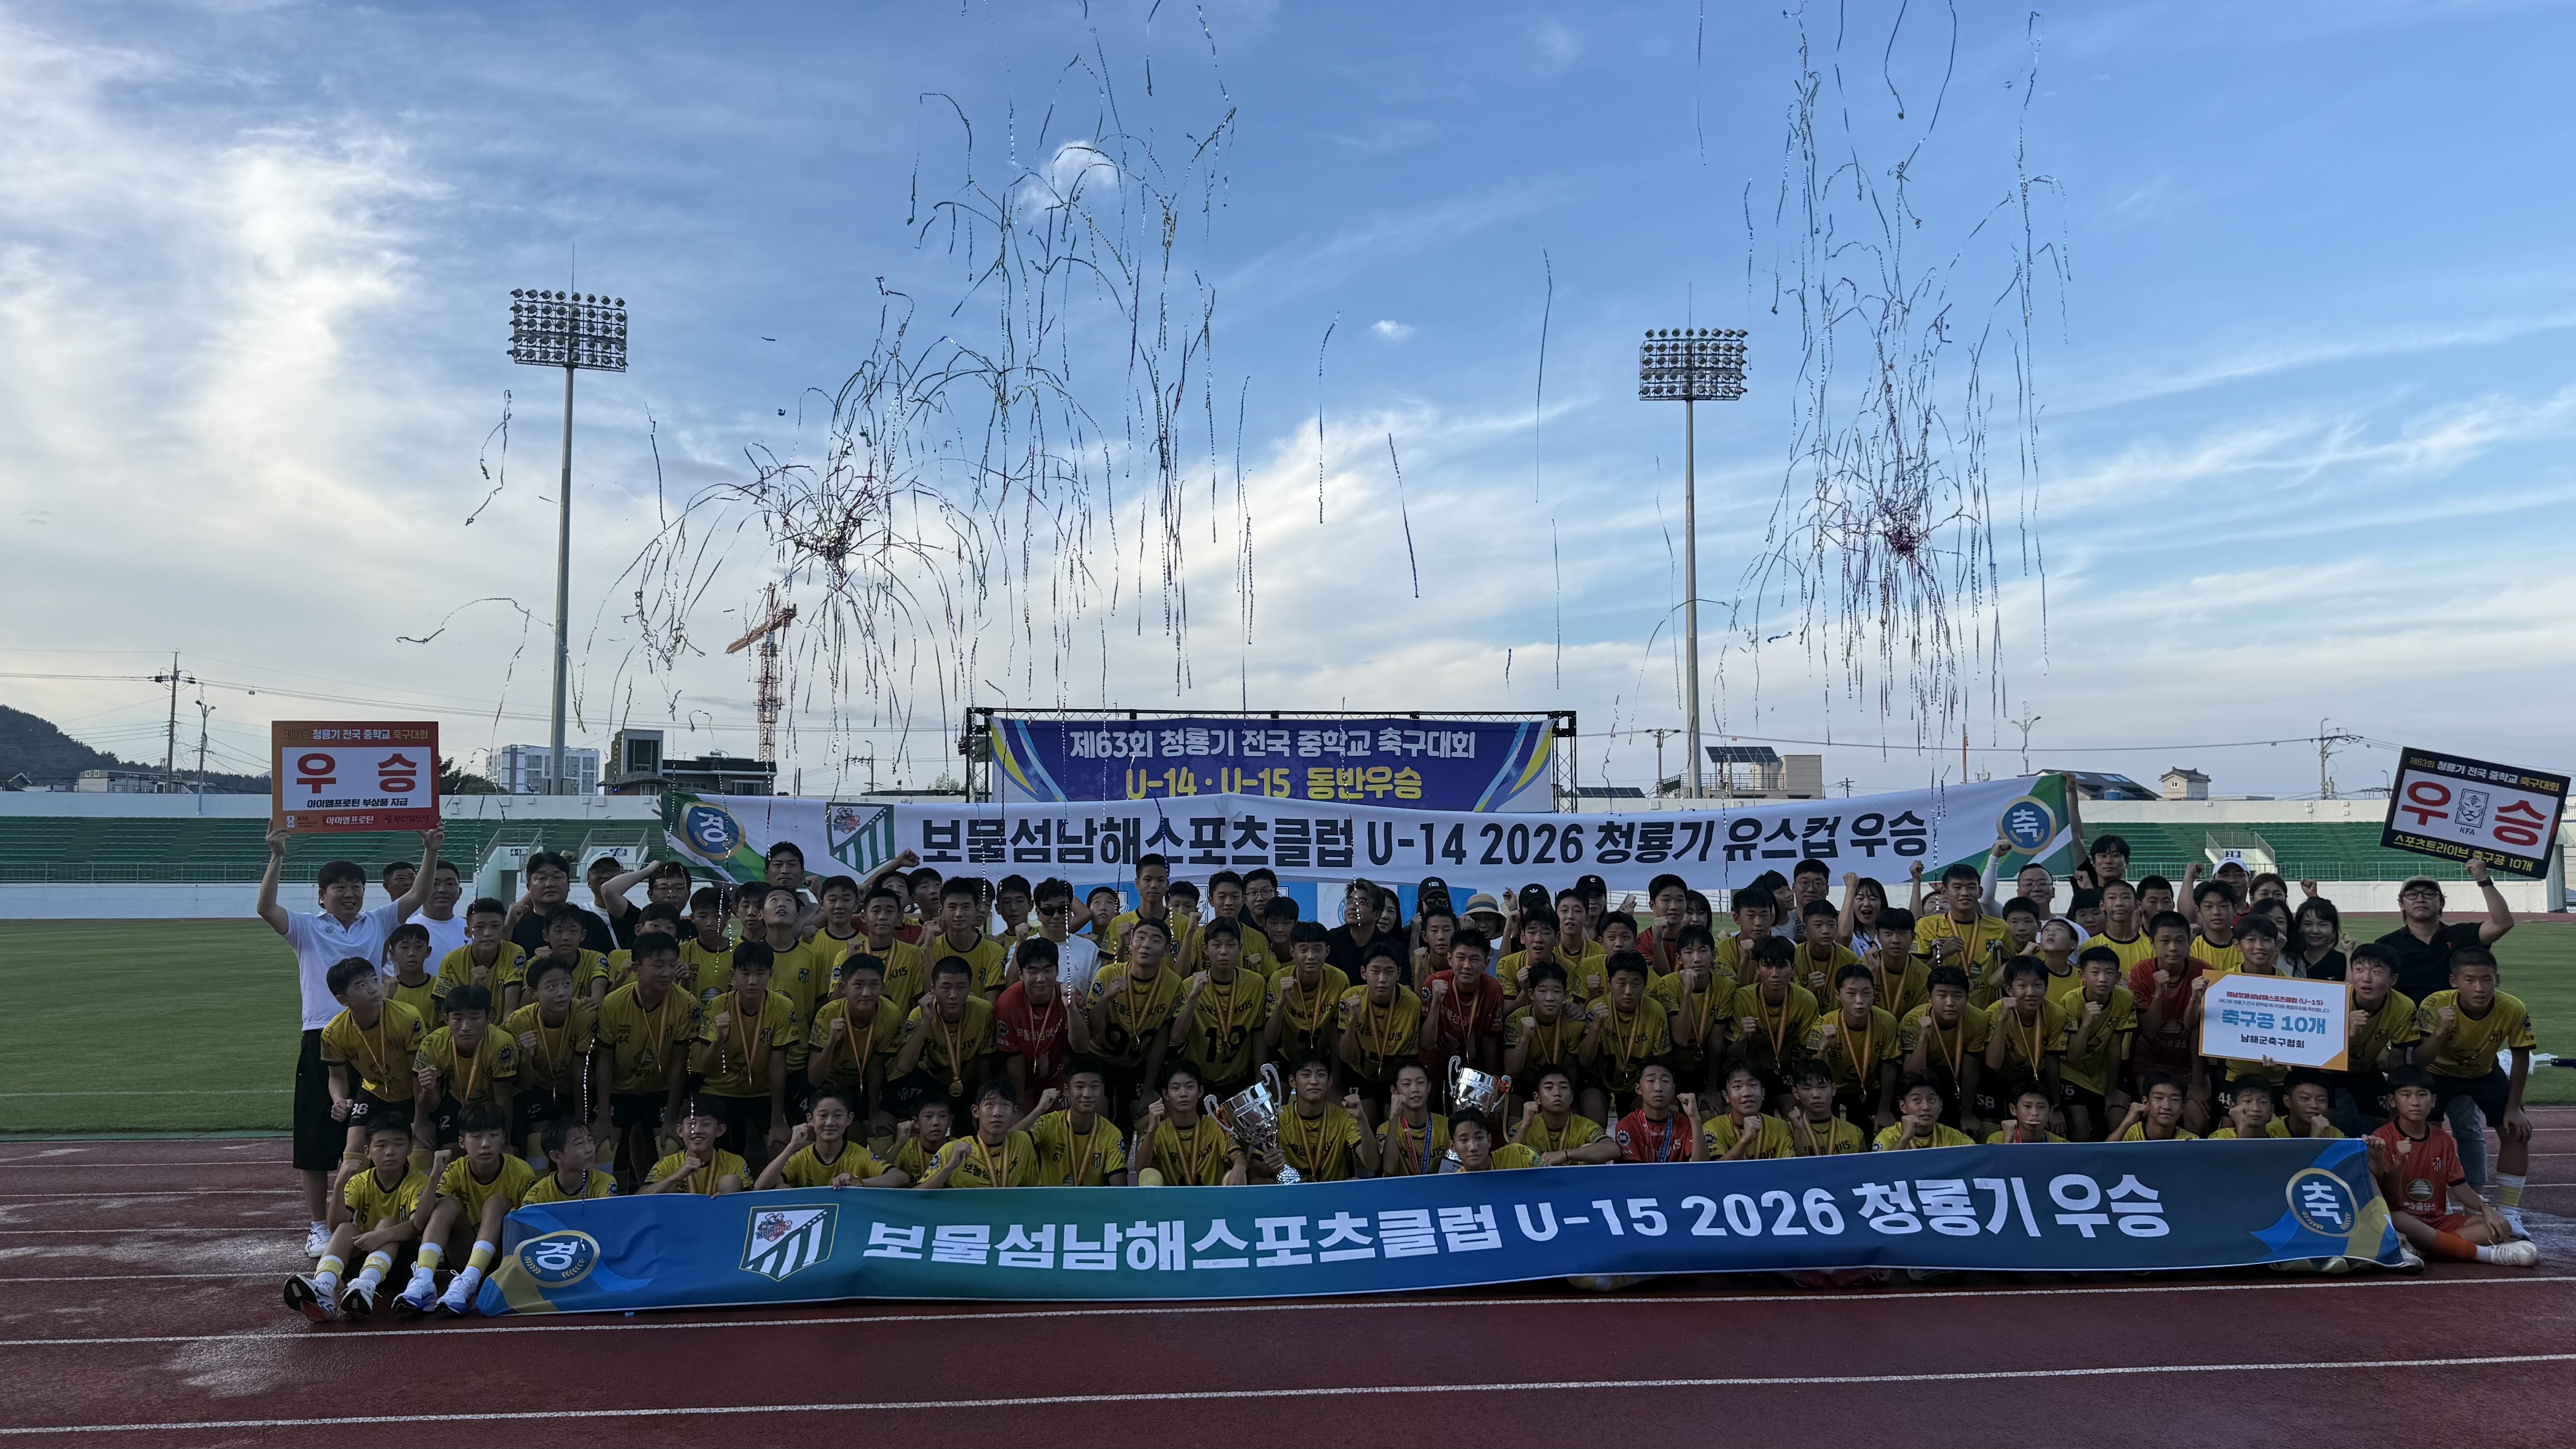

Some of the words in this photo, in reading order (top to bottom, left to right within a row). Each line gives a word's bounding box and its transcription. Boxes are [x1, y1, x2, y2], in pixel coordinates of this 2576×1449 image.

[313, 729, 340, 740] 청룡기
[343, 729, 361, 740] 전국
[363, 729, 390, 740] 중학교
[393, 729, 428, 740] 축구대회
[1070, 730, 1153, 758] 제63회
[1160, 727, 1234, 757] 청룡기
[1241, 729, 1290, 757] 전국
[1297, 729, 1371, 757] 중학교
[1378, 727, 1475, 758] 축구대회
[1126, 766, 1197, 800] U-14
[1221, 767, 1290, 798] U-15
[1307, 766, 1422, 799] 동반우승
[2409, 757, 2435, 769] 제63회
[2437, 761, 2466, 774] 청룡기
[2467, 767, 2488, 779] 전국
[2488, 770, 2518, 784] 중학교
[2520, 777, 2560, 792] 축구대회
[307, 798, 360, 808] 아이엠프로틴
[391, 798, 408, 806] 지급
[326, 815, 374, 825] 아이엠프로틴
[2012, 809, 2038, 837] 축
[2460, 827, 2475, 836] KFA
[923, 814, 1352, 867] 보물섬남해스포츠클럽
[1368, 822, 1467, 865] U-14
[1479, 823, 1584, 865] 2026
[1595, 820, 1715, 863] 청룡기
[1723, 816, 1841, 861] 유스컵
[1850, 810, 1927, 857] 우승
[2393, 834, 2469, 859] 스포츠트라이브
[2509, 857, 2533, 873] 10개
[2299, 997, 2323, 1006] (U-15)
[2222, 1009, 2274, 1029] 축구공
[2281, 1016, 2326, 1035] 10개
[1205, 1025, 1247, 1063] 19
[2240, 1034, 2305, 1049] 남해군축구협회
[2301, 1182, 2342, 1225] 축
[862, 1205, 1503, 1271] 보물섬남해스포츠클럽
[1513, 1198, 1668, 1242] U-15
[1681, 1188, 1845, 1237] 2026
[1852, 1177, 2042, 1237] 청룡기
[2048, 1174, 2170, 1238] 우승
[536, 1241, 579, 1270] 경
